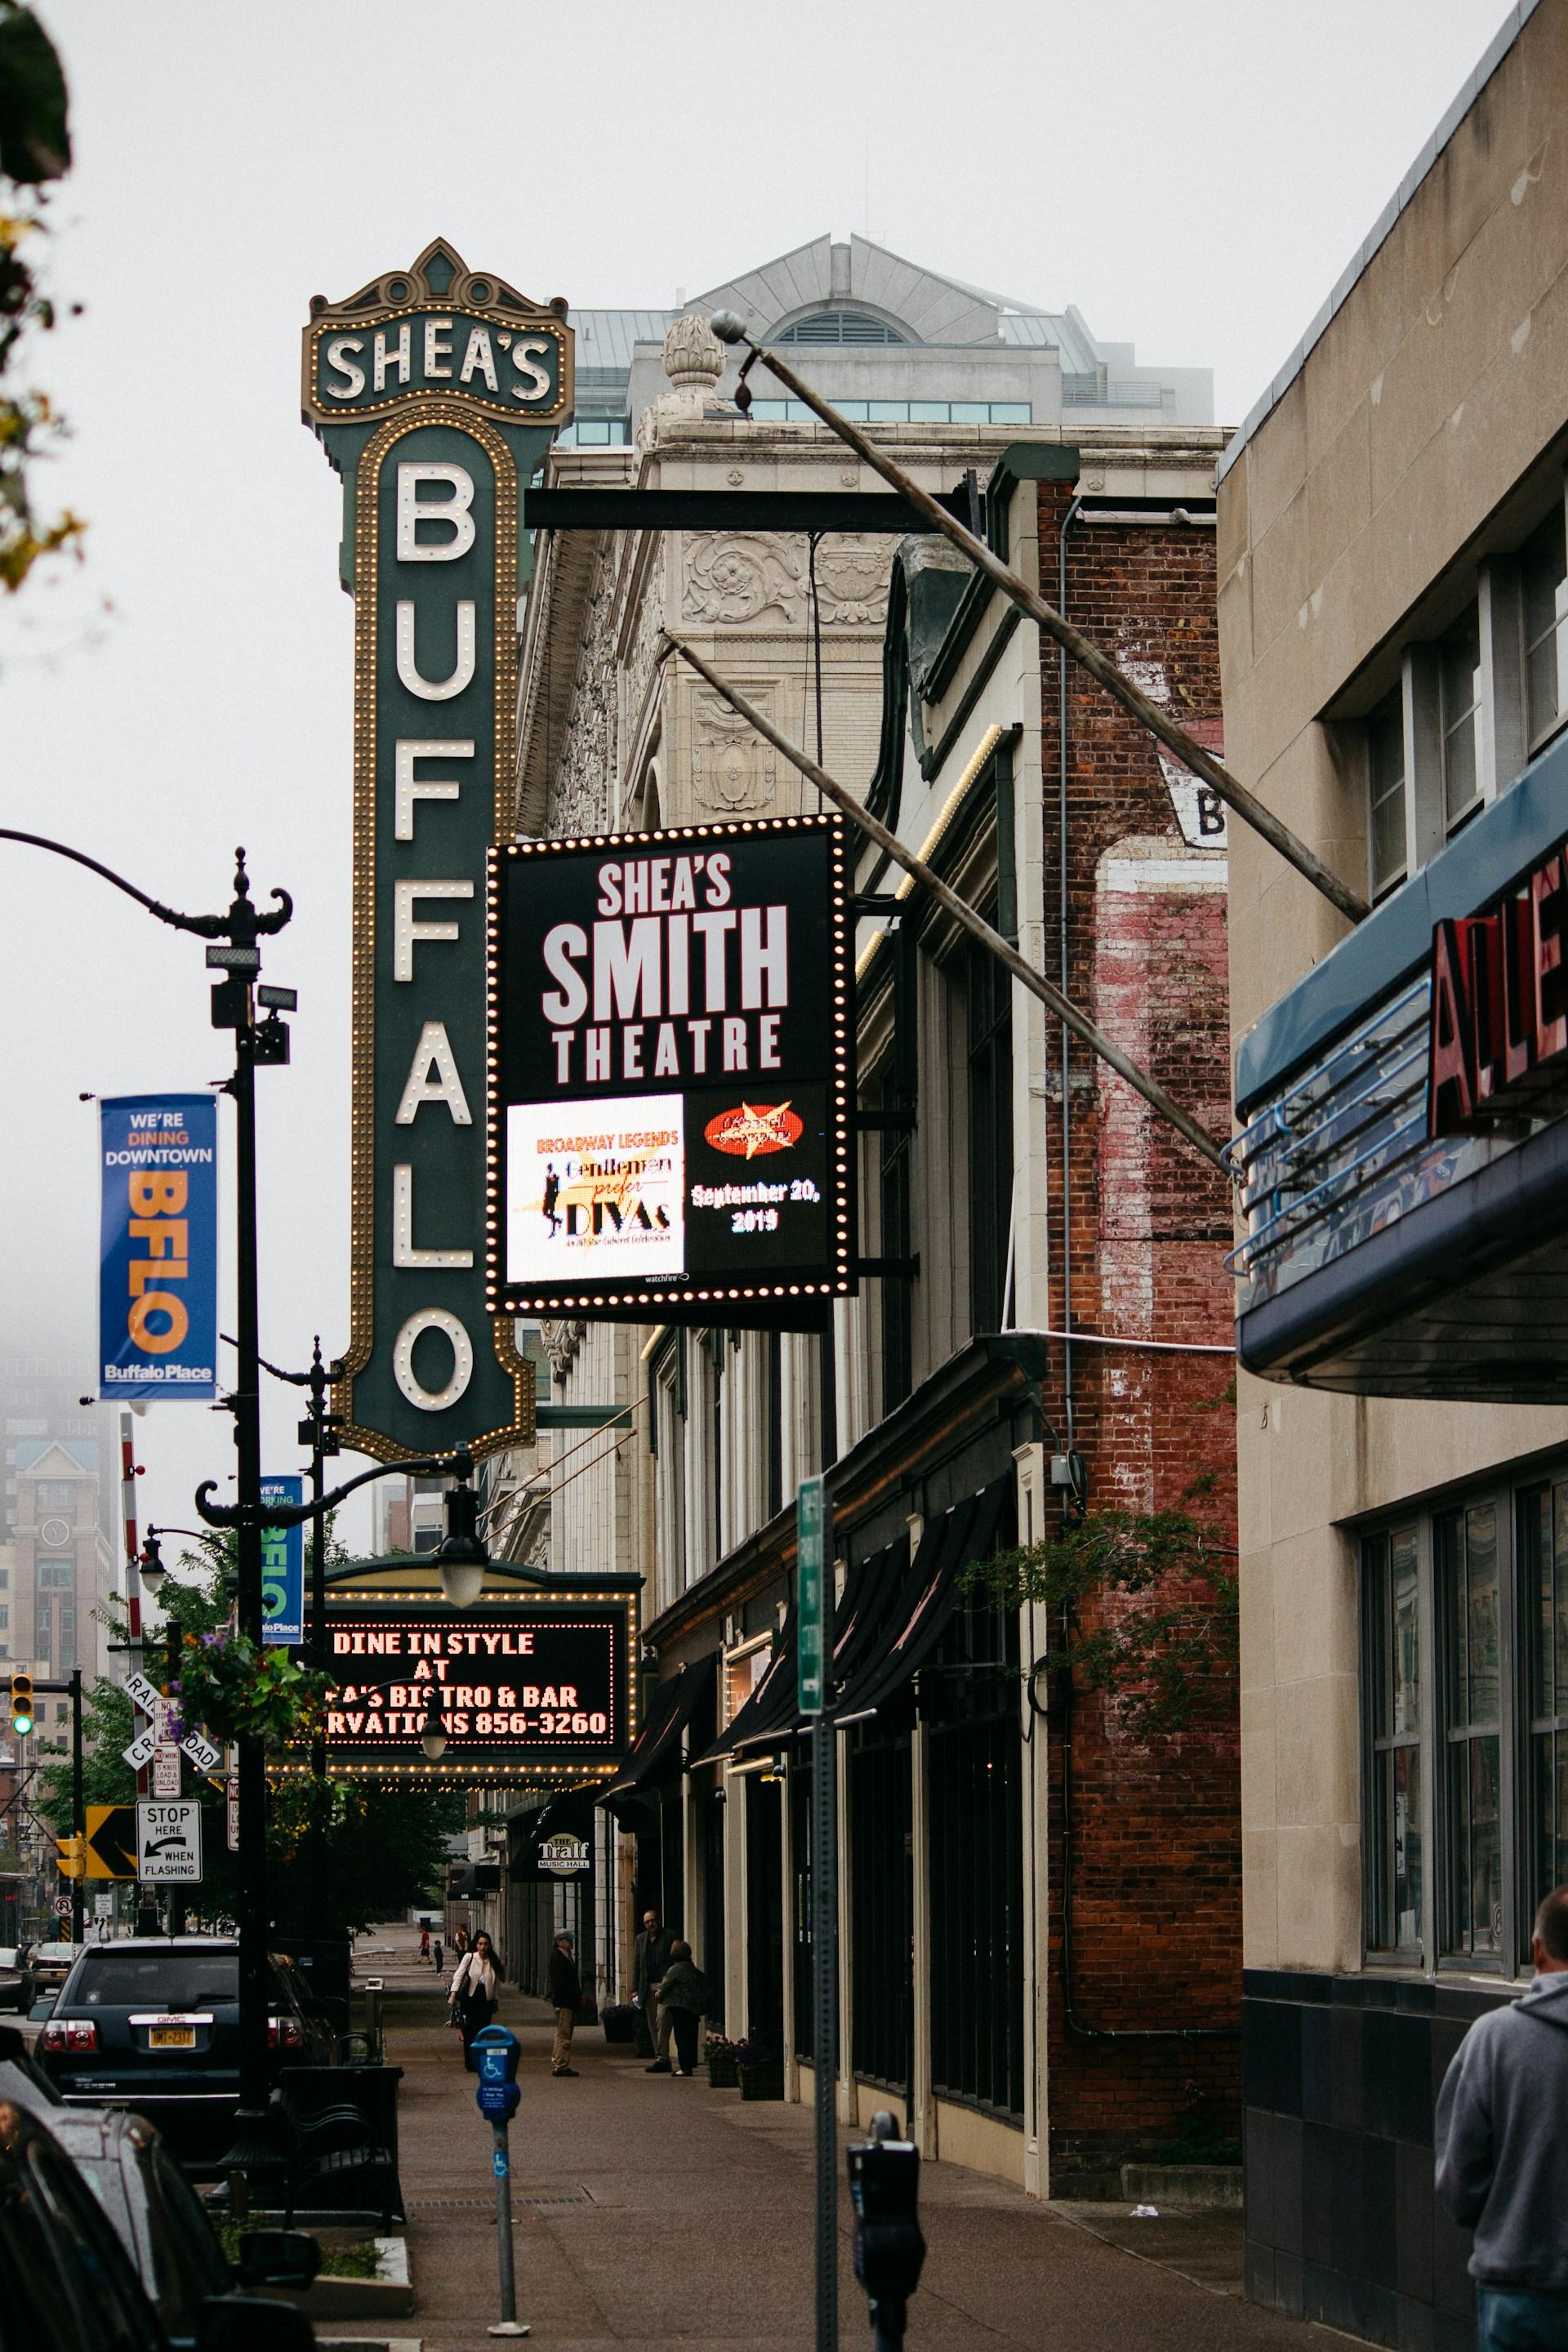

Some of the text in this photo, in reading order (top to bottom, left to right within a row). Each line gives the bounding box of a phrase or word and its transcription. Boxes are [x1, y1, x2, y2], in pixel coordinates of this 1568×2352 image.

[326, 318, 550, 401] SHEA'S
[597, 853, 731, 916] SHEA'S
[392, 461, 476, 1412] BUFFALO
[542, 904, 788, 1025] SMITH
[1430, 844, 1568, 1141] ALLE
[551, 1013, 782, 1084] THEATRE
[130, 1112, 184, 1128] WE'RE
[127, 1129, 189, 1147] DINING
[537, 1129, 679, 1154] BROADWAY LEGENDS
[105, 1148, 212, 1165] DOWNTOWN
[691, 1181, 788, 1209] September
[731, 1208, 779, 1233] 2019
[127, 1170, 189, 1354] BFLO
[645, 1275, 678, 1283] watchfire
[104, 1364, 212, 1379] Buffalo Place
[260, 1495, 294, 1503] ORKING
[274, 1623, 299, 1632] Place
[333, 1633, 534, 1655] DINE IN STYLE
[413, 1659, 450, 1682] AT
[390, 1686, 491, 1708] BISTRO
[497, 1686, 516, 1708] &
[523, 1686, 578, 1708] BAR
[475, 1712, 607, 1735] 856-3260
[147, 1807, 190, 1823] STOP
[155, 1825, 182, 1835] HERE
[164, 1851, 194, 1861] WHEN
[537, 1842, 590, 1859] Tralf
[145, 1865, 195, 1875] FLASHING
[157, 2016, 186, 2024] GMC
